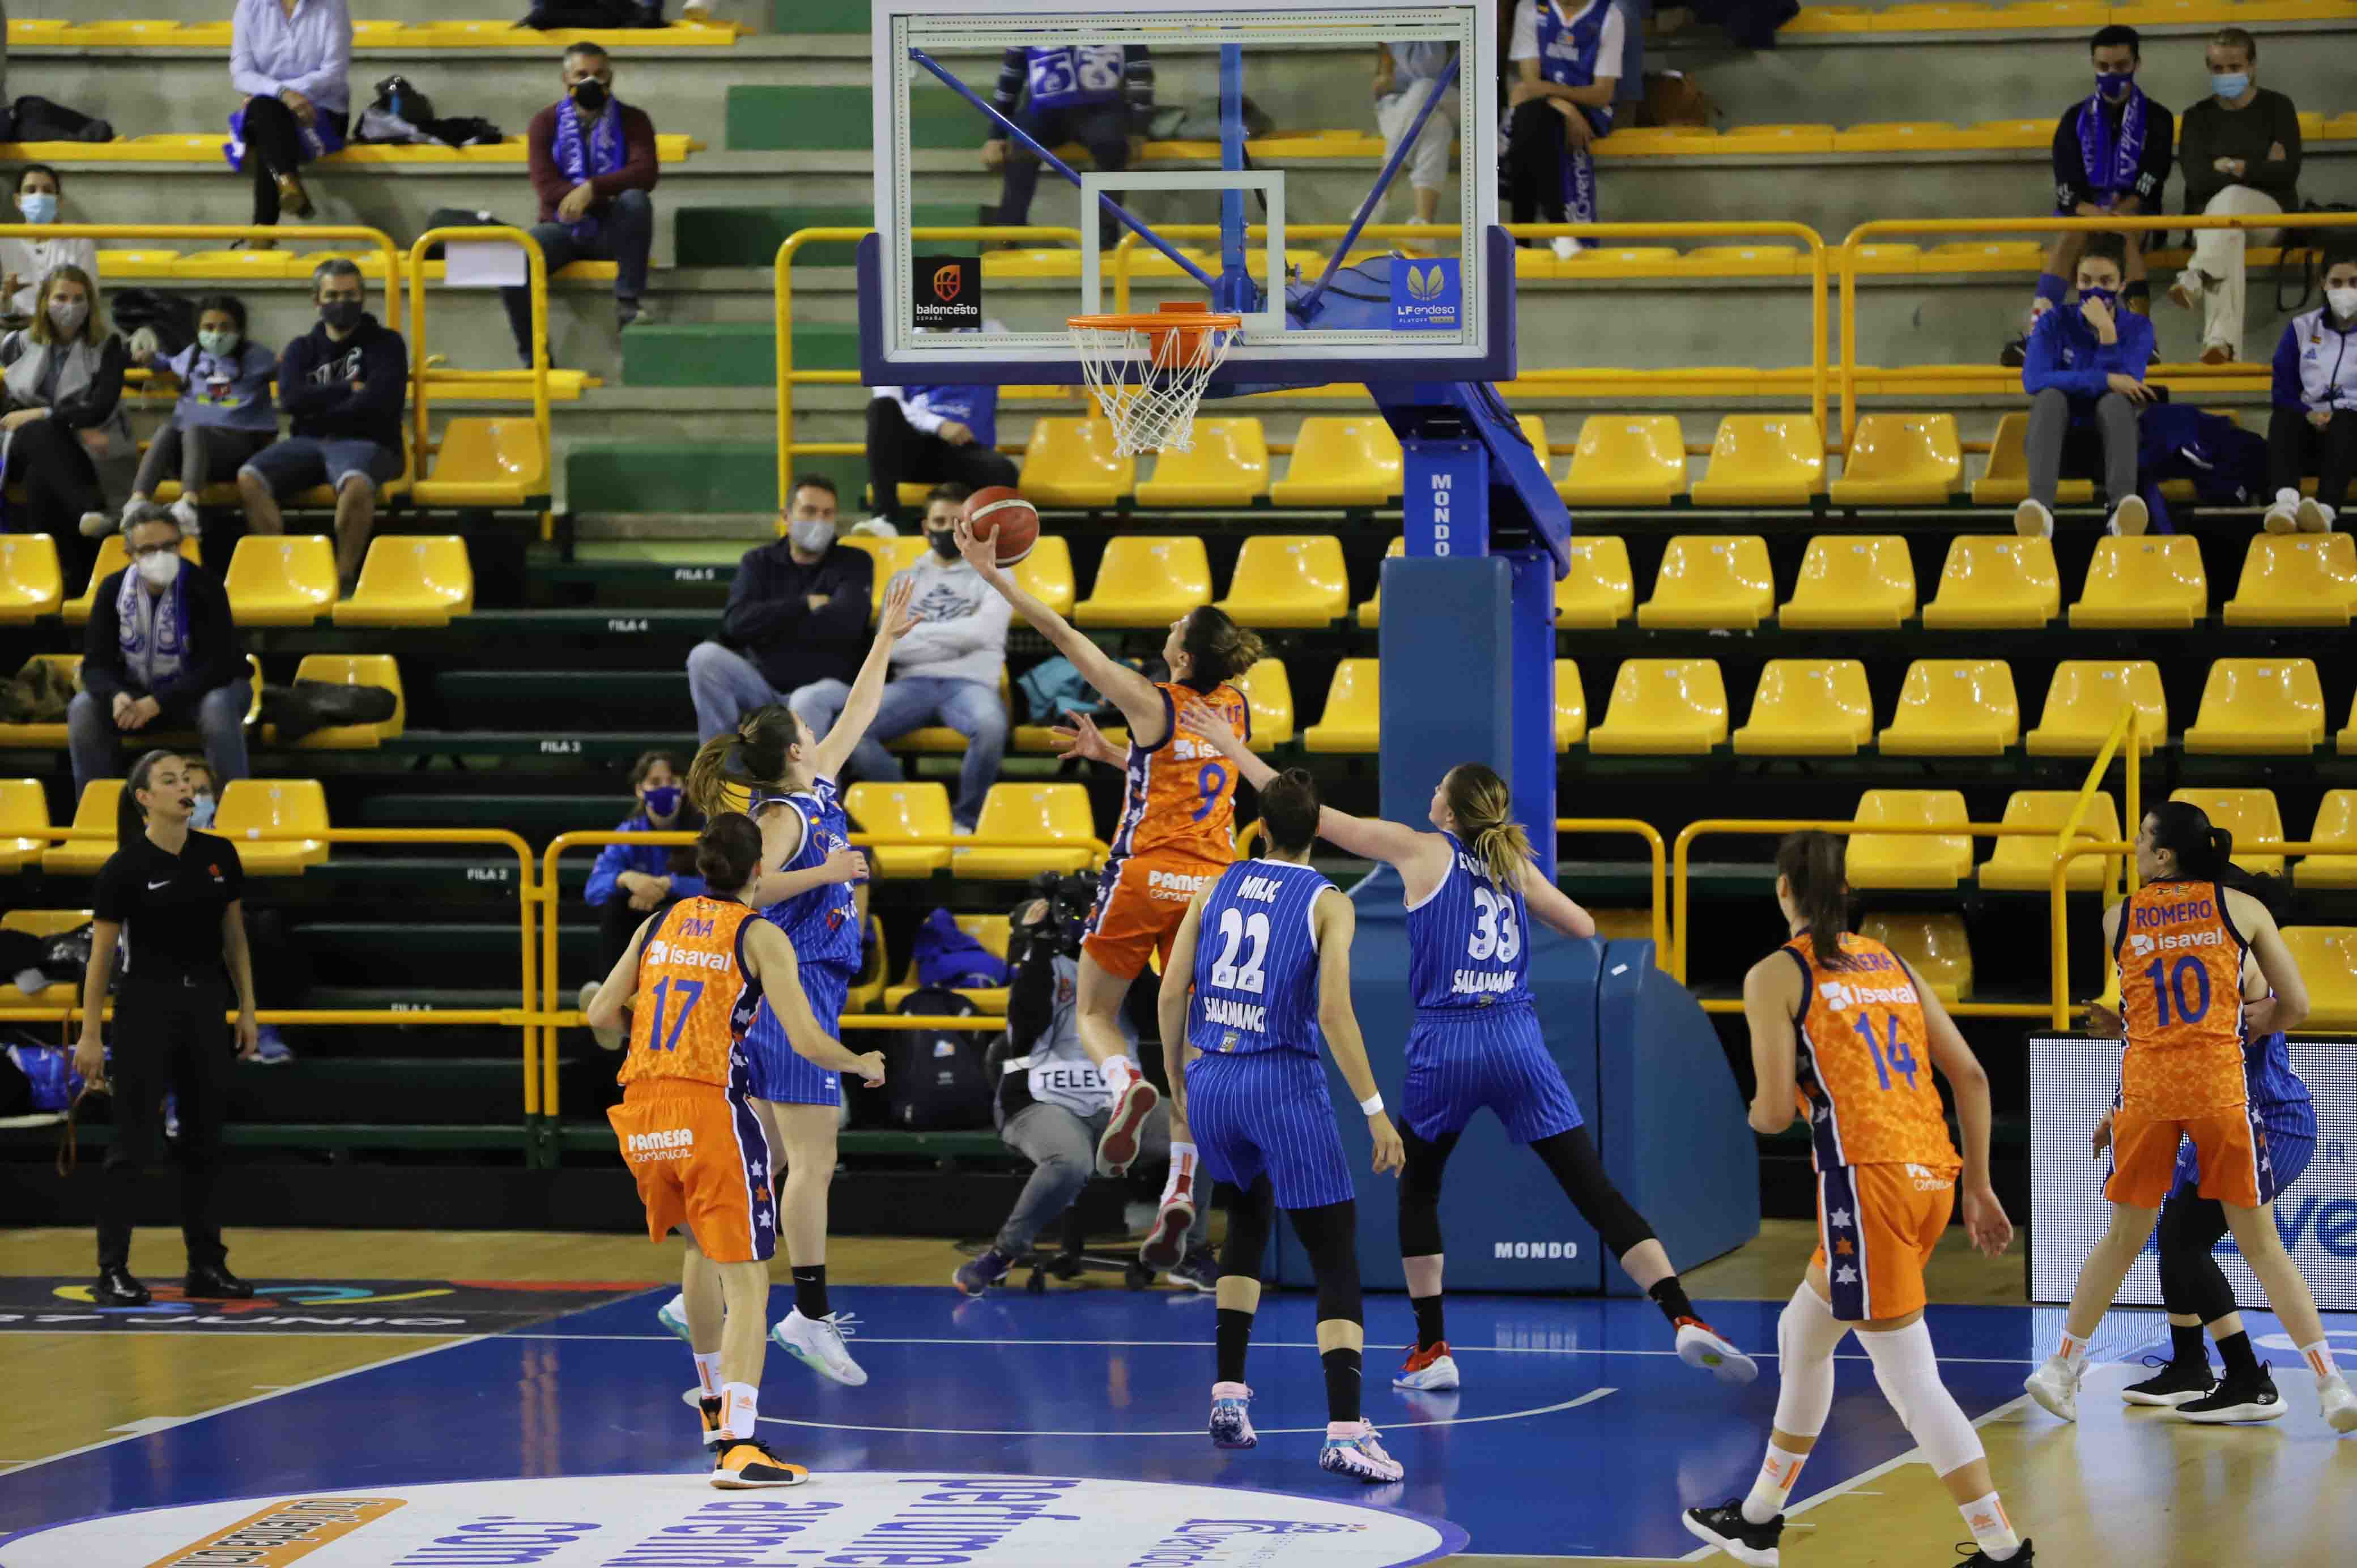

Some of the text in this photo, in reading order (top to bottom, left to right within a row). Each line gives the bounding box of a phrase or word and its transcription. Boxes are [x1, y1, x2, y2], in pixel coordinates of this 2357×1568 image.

[916, 303, 978, 314] baloncesto
[1431, 474, 1452, 557] MONDO
[608, 619, 648, 631] FILA 4
[541, 741, 581, 753] FILA 3
[1193, 762, 1227, 822] 9
[467, 868, 508, 880] FILA 2
[1467, 885, 1521, 964] 33
[2135, 900, 2213, 927] ROMERO
[677, 918, 715, 938] PINA
[2159, 927, 2223, 951] isaval
[670, 944, 733, 973] isaval
[1211, 907, 1270, 994] 22
[1852, 982, 1921, 1004] isaval
[2145, 955, 2211, 1027] 10
[649, 975, 705, 1052] 17
[1203, 996, 1267, 1034] SALAMANC
[1853, 1011, 1917, 1091] 14
[628, 1128, 694, 1152] PAMESA
[1495, 1242, 1578, 1260] MONDO
